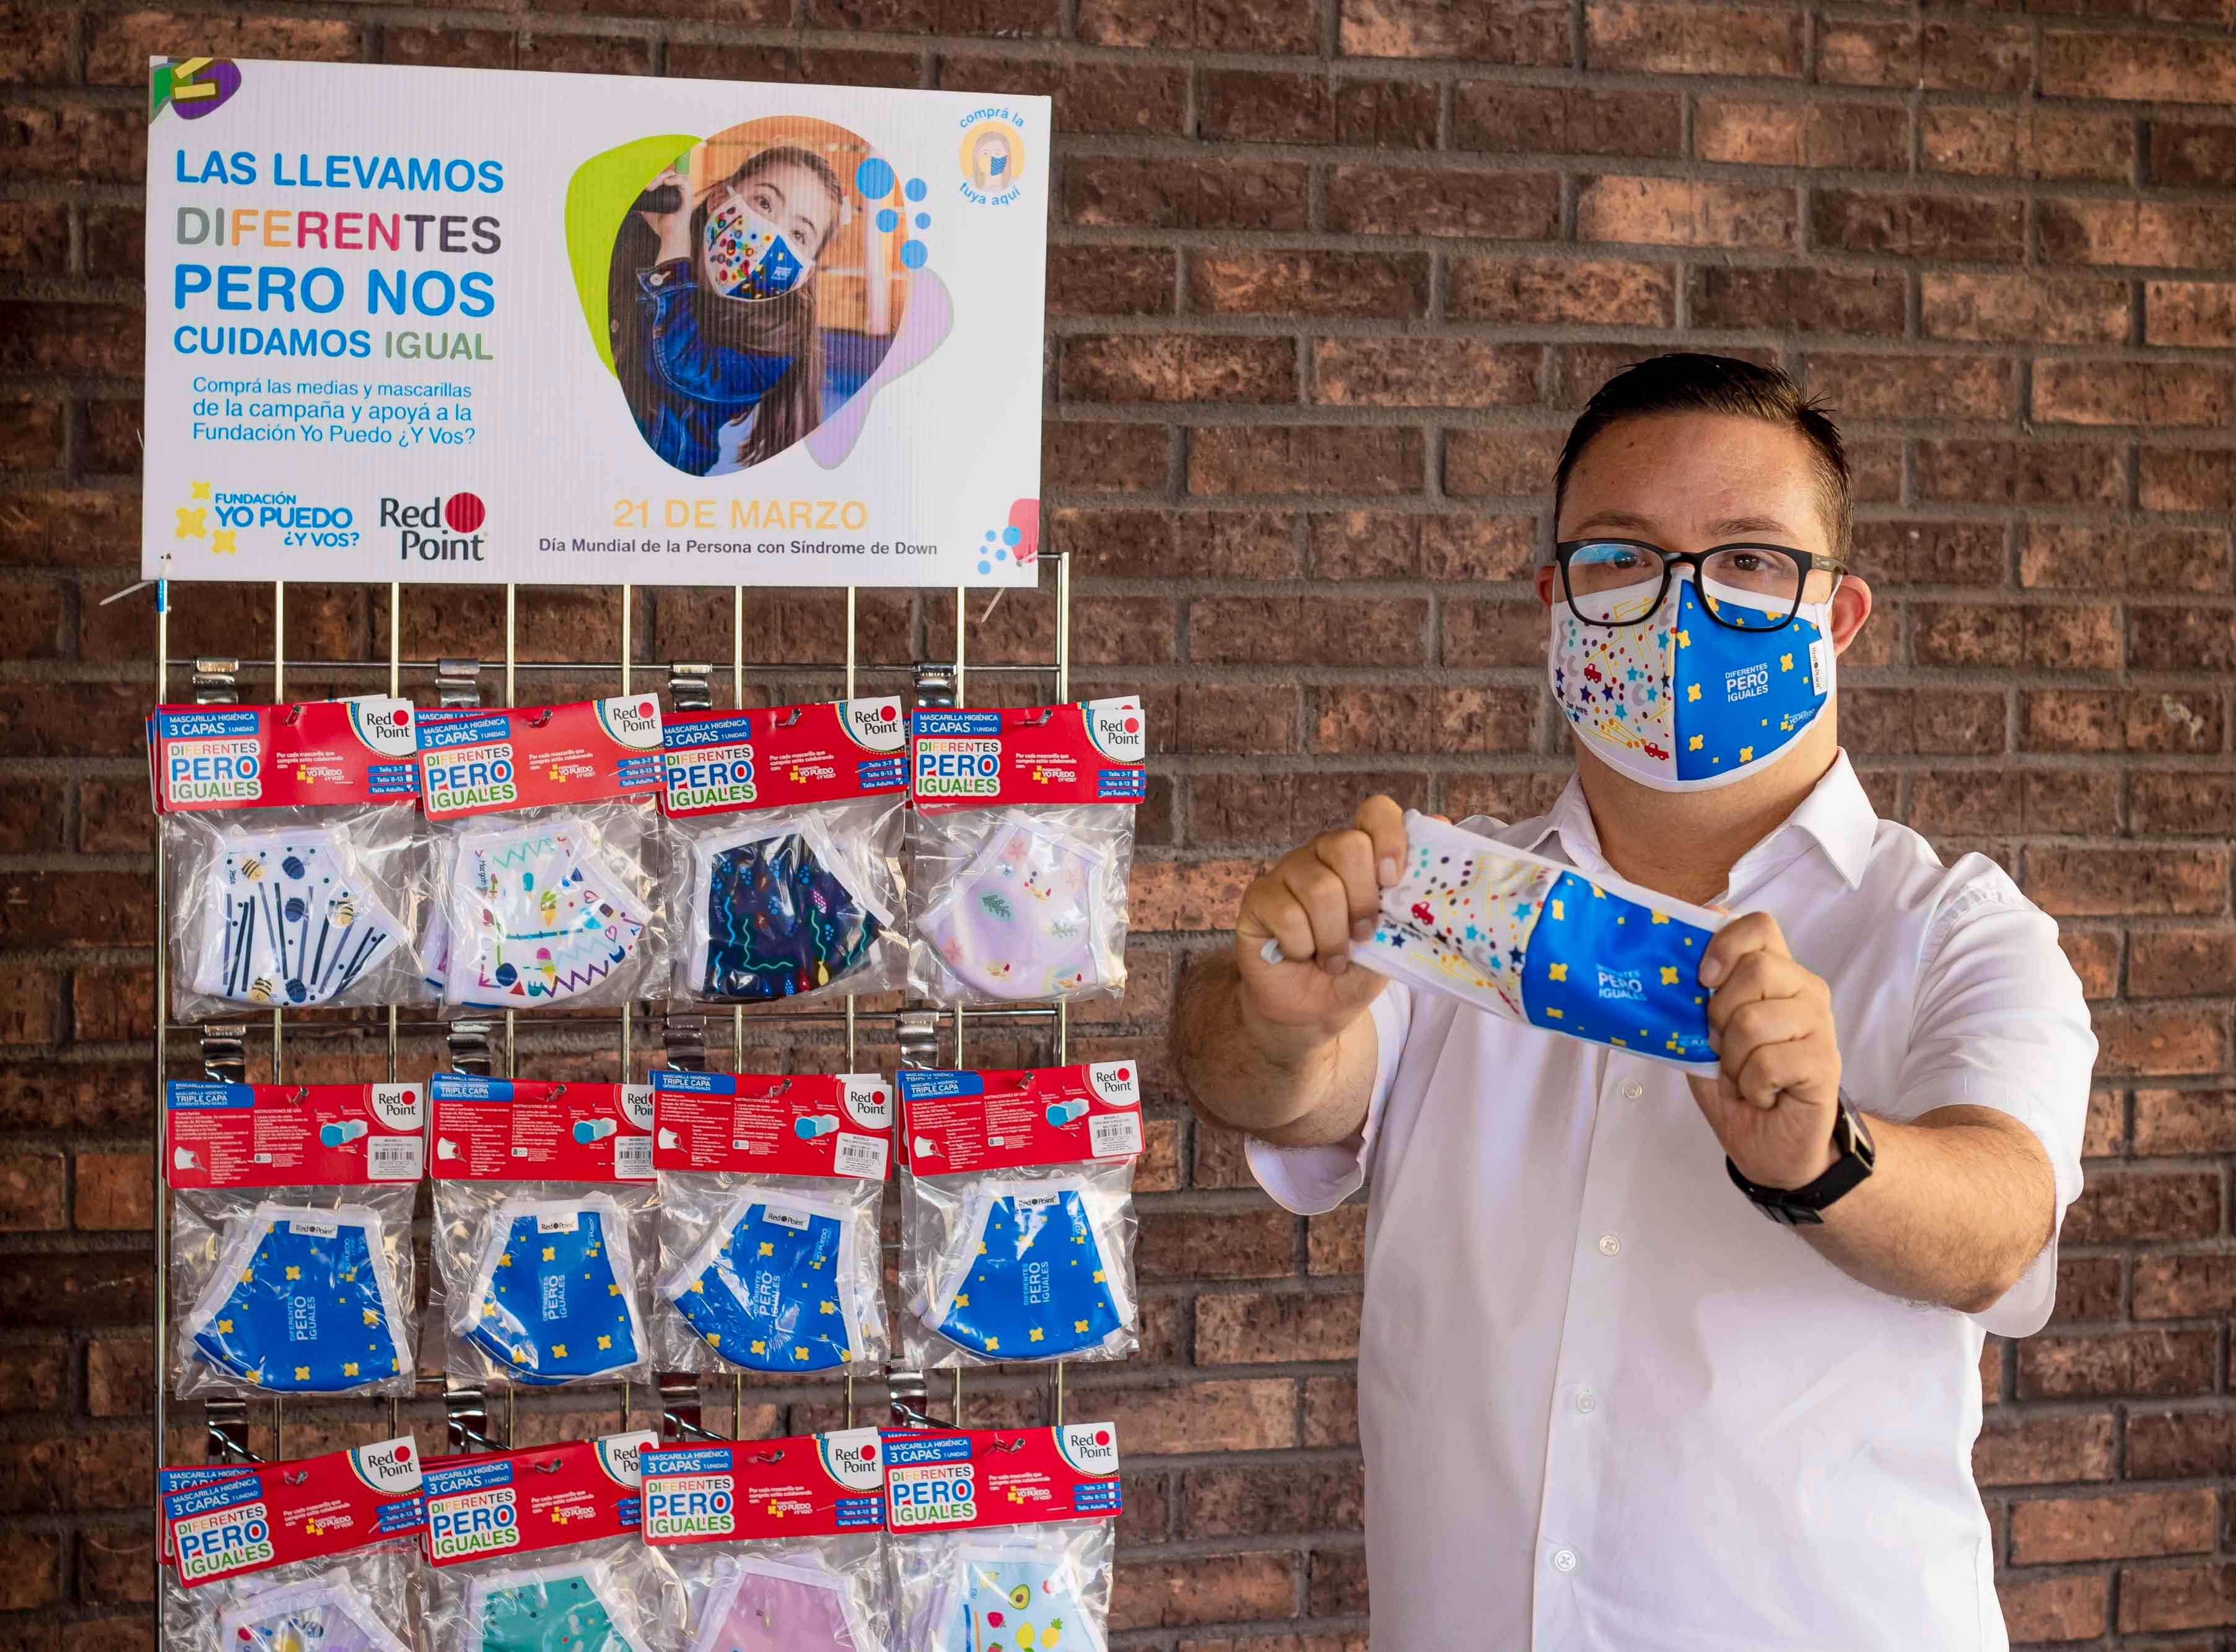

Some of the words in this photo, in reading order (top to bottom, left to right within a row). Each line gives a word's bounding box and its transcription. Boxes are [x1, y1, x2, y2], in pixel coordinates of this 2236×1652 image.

[960, 108, 1009, 128] comprá
[1012, 113, 1024, 127] la
[176, 149, 257, 185] LAS
[273, 153, 504, 193] LLEVAMOS
[960, 181, 986, 204] tuya
[177, 206, 502, 255] DIFERENTES
[174, 264, 344, 313] PERO
[367, 269, 496, 318] NOS
[173, 326, 371, 358] CUIDAMOS
[385, 331, 494, 361] IGUAL
[193, 377, 261, 396] Comprá
[267, 378, 291, 394] las
[297, 380, 358, 395] medias
[364, 385, 372, 399] y
[378, 382, 471, 398] mascarillas
[193, 399, 219, 416] de
[225, 400, 243, 417] la
[249, 401, 345, 420] campaña
[351, 406, 362, 423] y
[369, 402, 430, 424] apoyá
[436, 408, 448, 421] a
[455, 403, 471, 421] la
[193, 422, 295, 442] Fundación
[300, 425, 323, 442] Yo
[330, 426, 392, 443] Puedo
[398, 427, 424, 447] ¿Y
[429, 427, 475, 445] Vos?
[215, 491, 296, 505] FUNDACIÓN
[215, 506, 254, 528] YO
[260, 507, 352, 529] PUEDO
[380, 497, 440, 528] Red
[614, 499, 649, 528] 21
[665, 499, 716, 528] DE
[731, 499, 868, 531] MARZO
[284, 531, 307, 546] ¿Y
[312, 532, 360, 548] VOS?
[401, 530, 484, 561] Point
[539, 538, 566, 553] Día
[572, 538, 636, 553] Mundial
[641, 539, 660, 554] de
[666, 539, 681, 554] la
[686, 540, 752, 555] Persona
[757, 543, 785, 555] con
[790, 539, 865, 556] Síndrome
[870, 541, 889, 556] de
[894, 541, 937, 556] Down
[1724, 663, 1768, 679] DIFERENTES
[1726, 670, 1768, 693] PERO
[1727, 684, 1768, 702] IGUALES
[170, 715, 217, 723] MASCARILLA
[218, 712, 255, 722] HIGIÉNICA
[367, 713, 391, 725] Red
[613, 707, 637, 720] Red
[855, 710, 880, 723] Red
[964, 713, 998, 721] HIGIÉNICA
[170, 725, 178, 735] 3
[181, 722, 225, 735] CAPAS
[377, 725, 410, 738] Point
[424, 722, 469, 735] MASCARILLA
[470, 718, 506, 729] HIGIÉNICA
[623, 717, 656, 732] Point
[664, 722, 709, 734] MASCARILLA
[710, 719, 747, 729] HIGIÉNICA
[864, 721, 897, 735] Point
[920, 722, 927, 733] 3
[930, 722, 971, 733] CAPAS
[1101, 720, 1123, 732] Red
[424, 735, 432, 746] 3
[435, 730, 478, 745] CAPAS
[665, 736, 673, 746] 3
[676, 732, 718, 745] CAPAS
[920, 742, 998, 752] DIFERENTES
[1108, 732, 1139, 745] Point
[171, 743, 257, 756] DIFERENTES
[427, 747, 510, 767] DIFERENTES
[667, 748, 751, 766] DIFERENTES
[172, 756, 258, 782] PERO
[810, 767, 834, 775] PUEDO
[920, 754, 998, 776] PERO
[427, 759, 512, 792] PERO
[668, 761, 752, 791] PERO
[173, 781, 259, 799] IGUALES
[919, 778, 997, 793] IGUALES
[430, 784, 514, 809] IGUALES
[670, 785, 754, 807] IGUALES
[1096, 1072, 1117, 1082] Red
[1104, 1080, 1132, 1092] Point
[379, 1093, 401, 1104] Red
[851, 1091, 870, 1103] Red
[386, 1104, 416, 1116] Point
[857, 1103, 885, 1114] Point
[295, 1225, 309, 1233] Red
[315, 1226, 333, 1235] Point
[1030, 1262, 1041, 1304] PERO
[548, 1275, 559, 1320] PERO
[295, 1296, 308, 1340] PERO
[308, 1296, 318, 1340] IGUALES
[1071, 1435, 1094, 1446] Red
[368, 1453, 395, 1468] Red
[835, 1448, 858, 1461] Red
[890, 1453, 897, 1463] 3
[900, 1449, 941, 1462] CAPAS
[1080, 1444, 1112, 1459] Point
[379, 1461, 414, 1479] Point
[649, 1463, 656, 1473] 3
[658, 1460, 701, 1472] CAPAS
[844, 1458, 876, 1473] Point
[892, 1467, 971, 1482] DIFERENTES
[649, 1479, 730, 1492] DIFERENTES
[893, 1479, 972, 1506] PERO
[175, 1505, 183, 1516] 3
[186, 1496, 230, 1514] CAPAS
[431, 1491, 513, 1514] DIFERENTES
[650, 1492, 732, 1518] PERO
[178, 1506, 263, 1535] DIFERENTES
[433, 1504, 515, 1539] PERO
[894, 1503, 974, 1523] IGUALES
[650, 1516, 732, 1534] IGUALES
[180, 1519, 267, 1560] PERO
[435, 1528, 517, 1555] IGUALES
[185, 1543, 271, 1576] IGUALES
